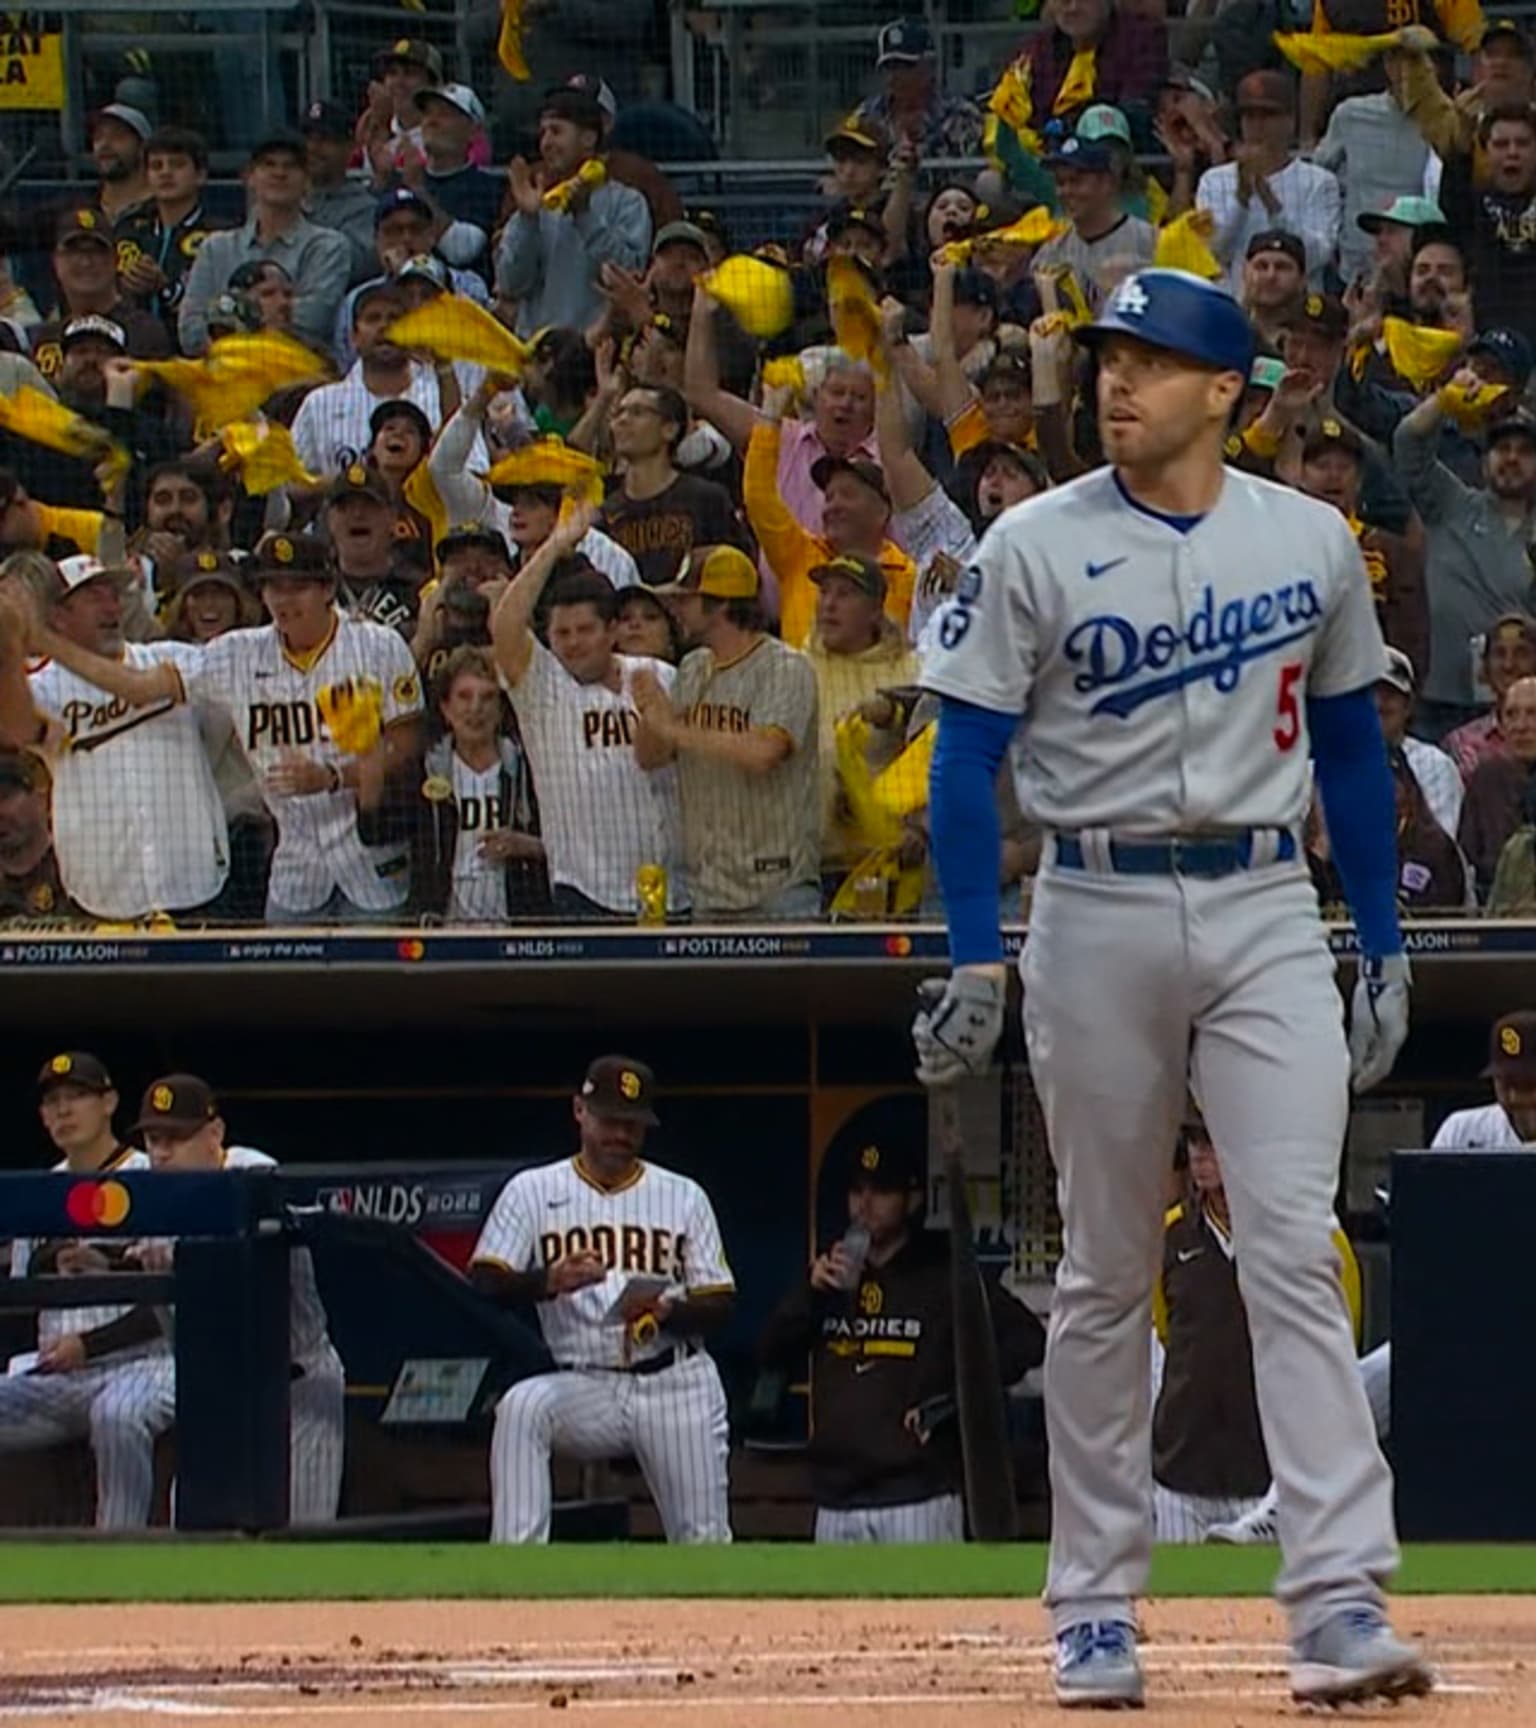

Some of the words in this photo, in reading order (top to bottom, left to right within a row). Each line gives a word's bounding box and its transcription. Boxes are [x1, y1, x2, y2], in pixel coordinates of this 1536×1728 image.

[1063, 583, 1322, 693] Dodgers
[1273, 662, 1303, 753] 5
[16, 944, 119, 961] POSTSEASON
[517, 940, 555, 955] NLDS
[678, 937, 781, 953] POSTSEASON
[354, 1185, 423, 1223] NLDS
[823, 1317, 921, 1338] PADRES
